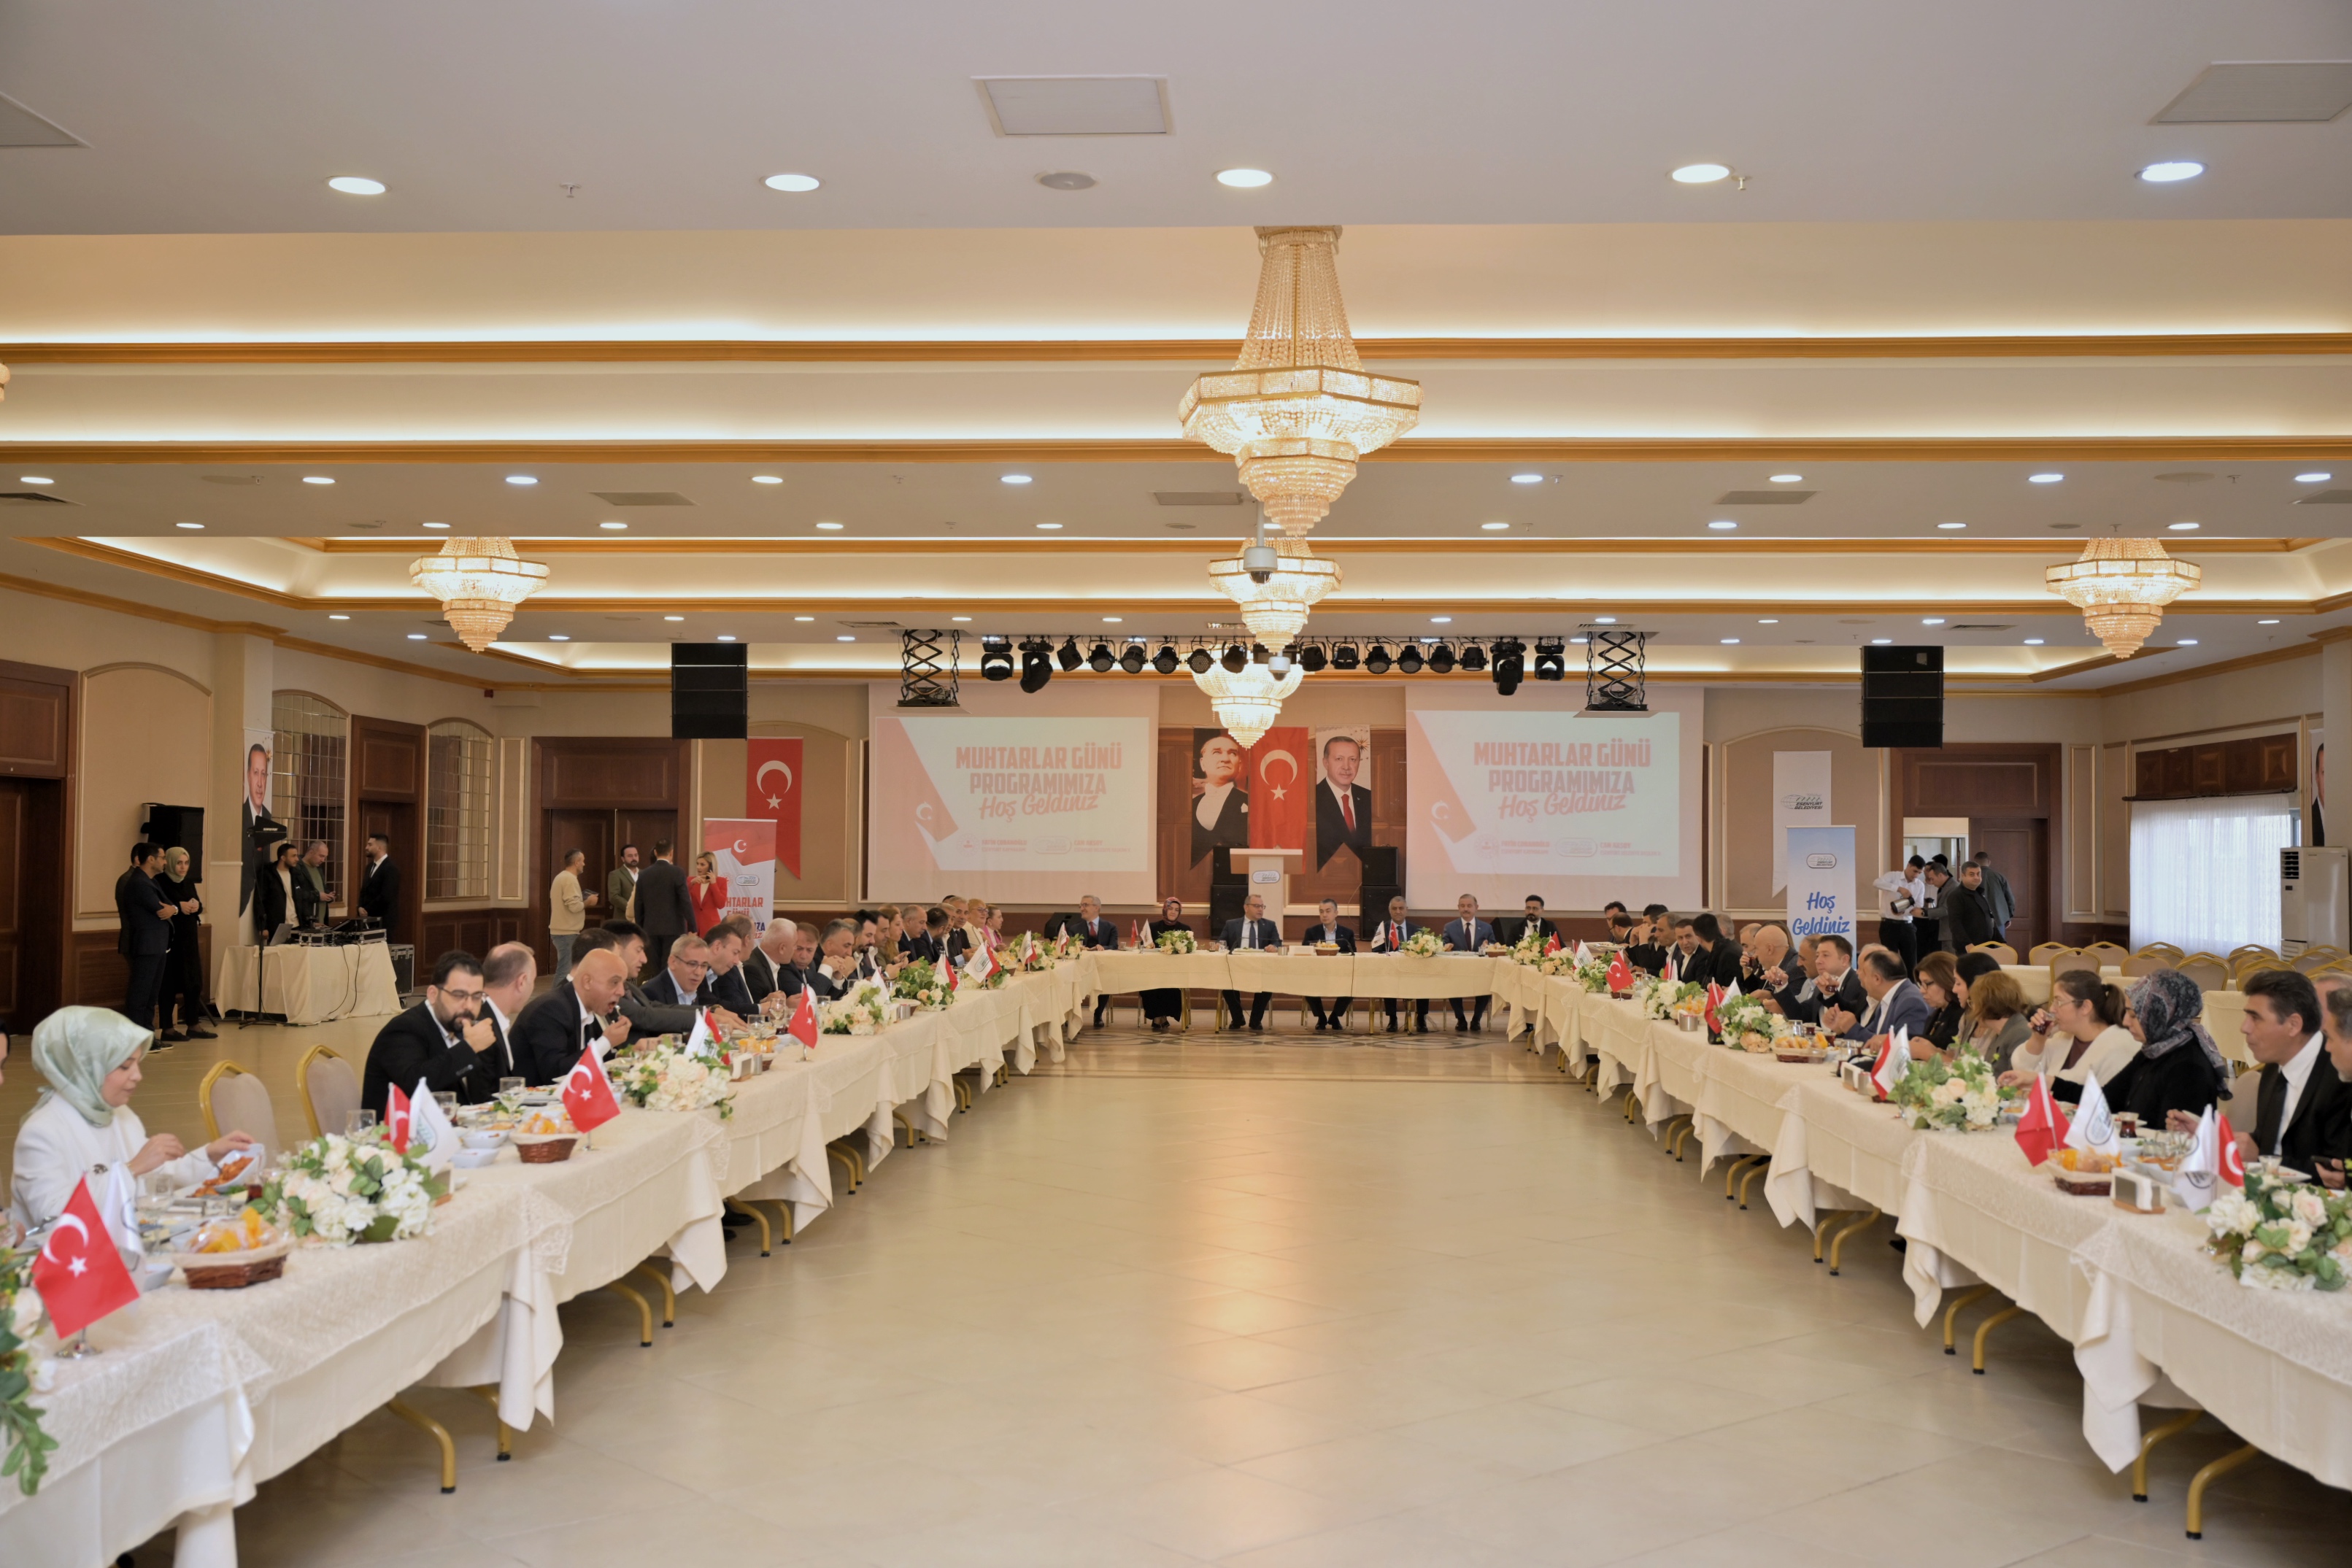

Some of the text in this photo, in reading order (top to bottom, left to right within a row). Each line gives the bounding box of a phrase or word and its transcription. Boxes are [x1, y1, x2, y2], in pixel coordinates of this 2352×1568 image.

[956, 741, 1122, 770] MUHTARLAR GÜNÜ
[1473, 738, 1651, 768] MUHTARLAR GÜNÜ
[970, 772, 1107, 795] PROGRAMIMIZA
[1489, 769, 1635, 795] PROGRAMIMIZA
[979, 789, 1099, 823] Hoş Geldiniz
[1498, 789, 1627, 823] Hoş Geldiniz
[726, 897, 764, 908] HTARLAR
[1806, 891, 1836, 914] Hoş
[1792, 916, 1851, 936] Geldiniz
